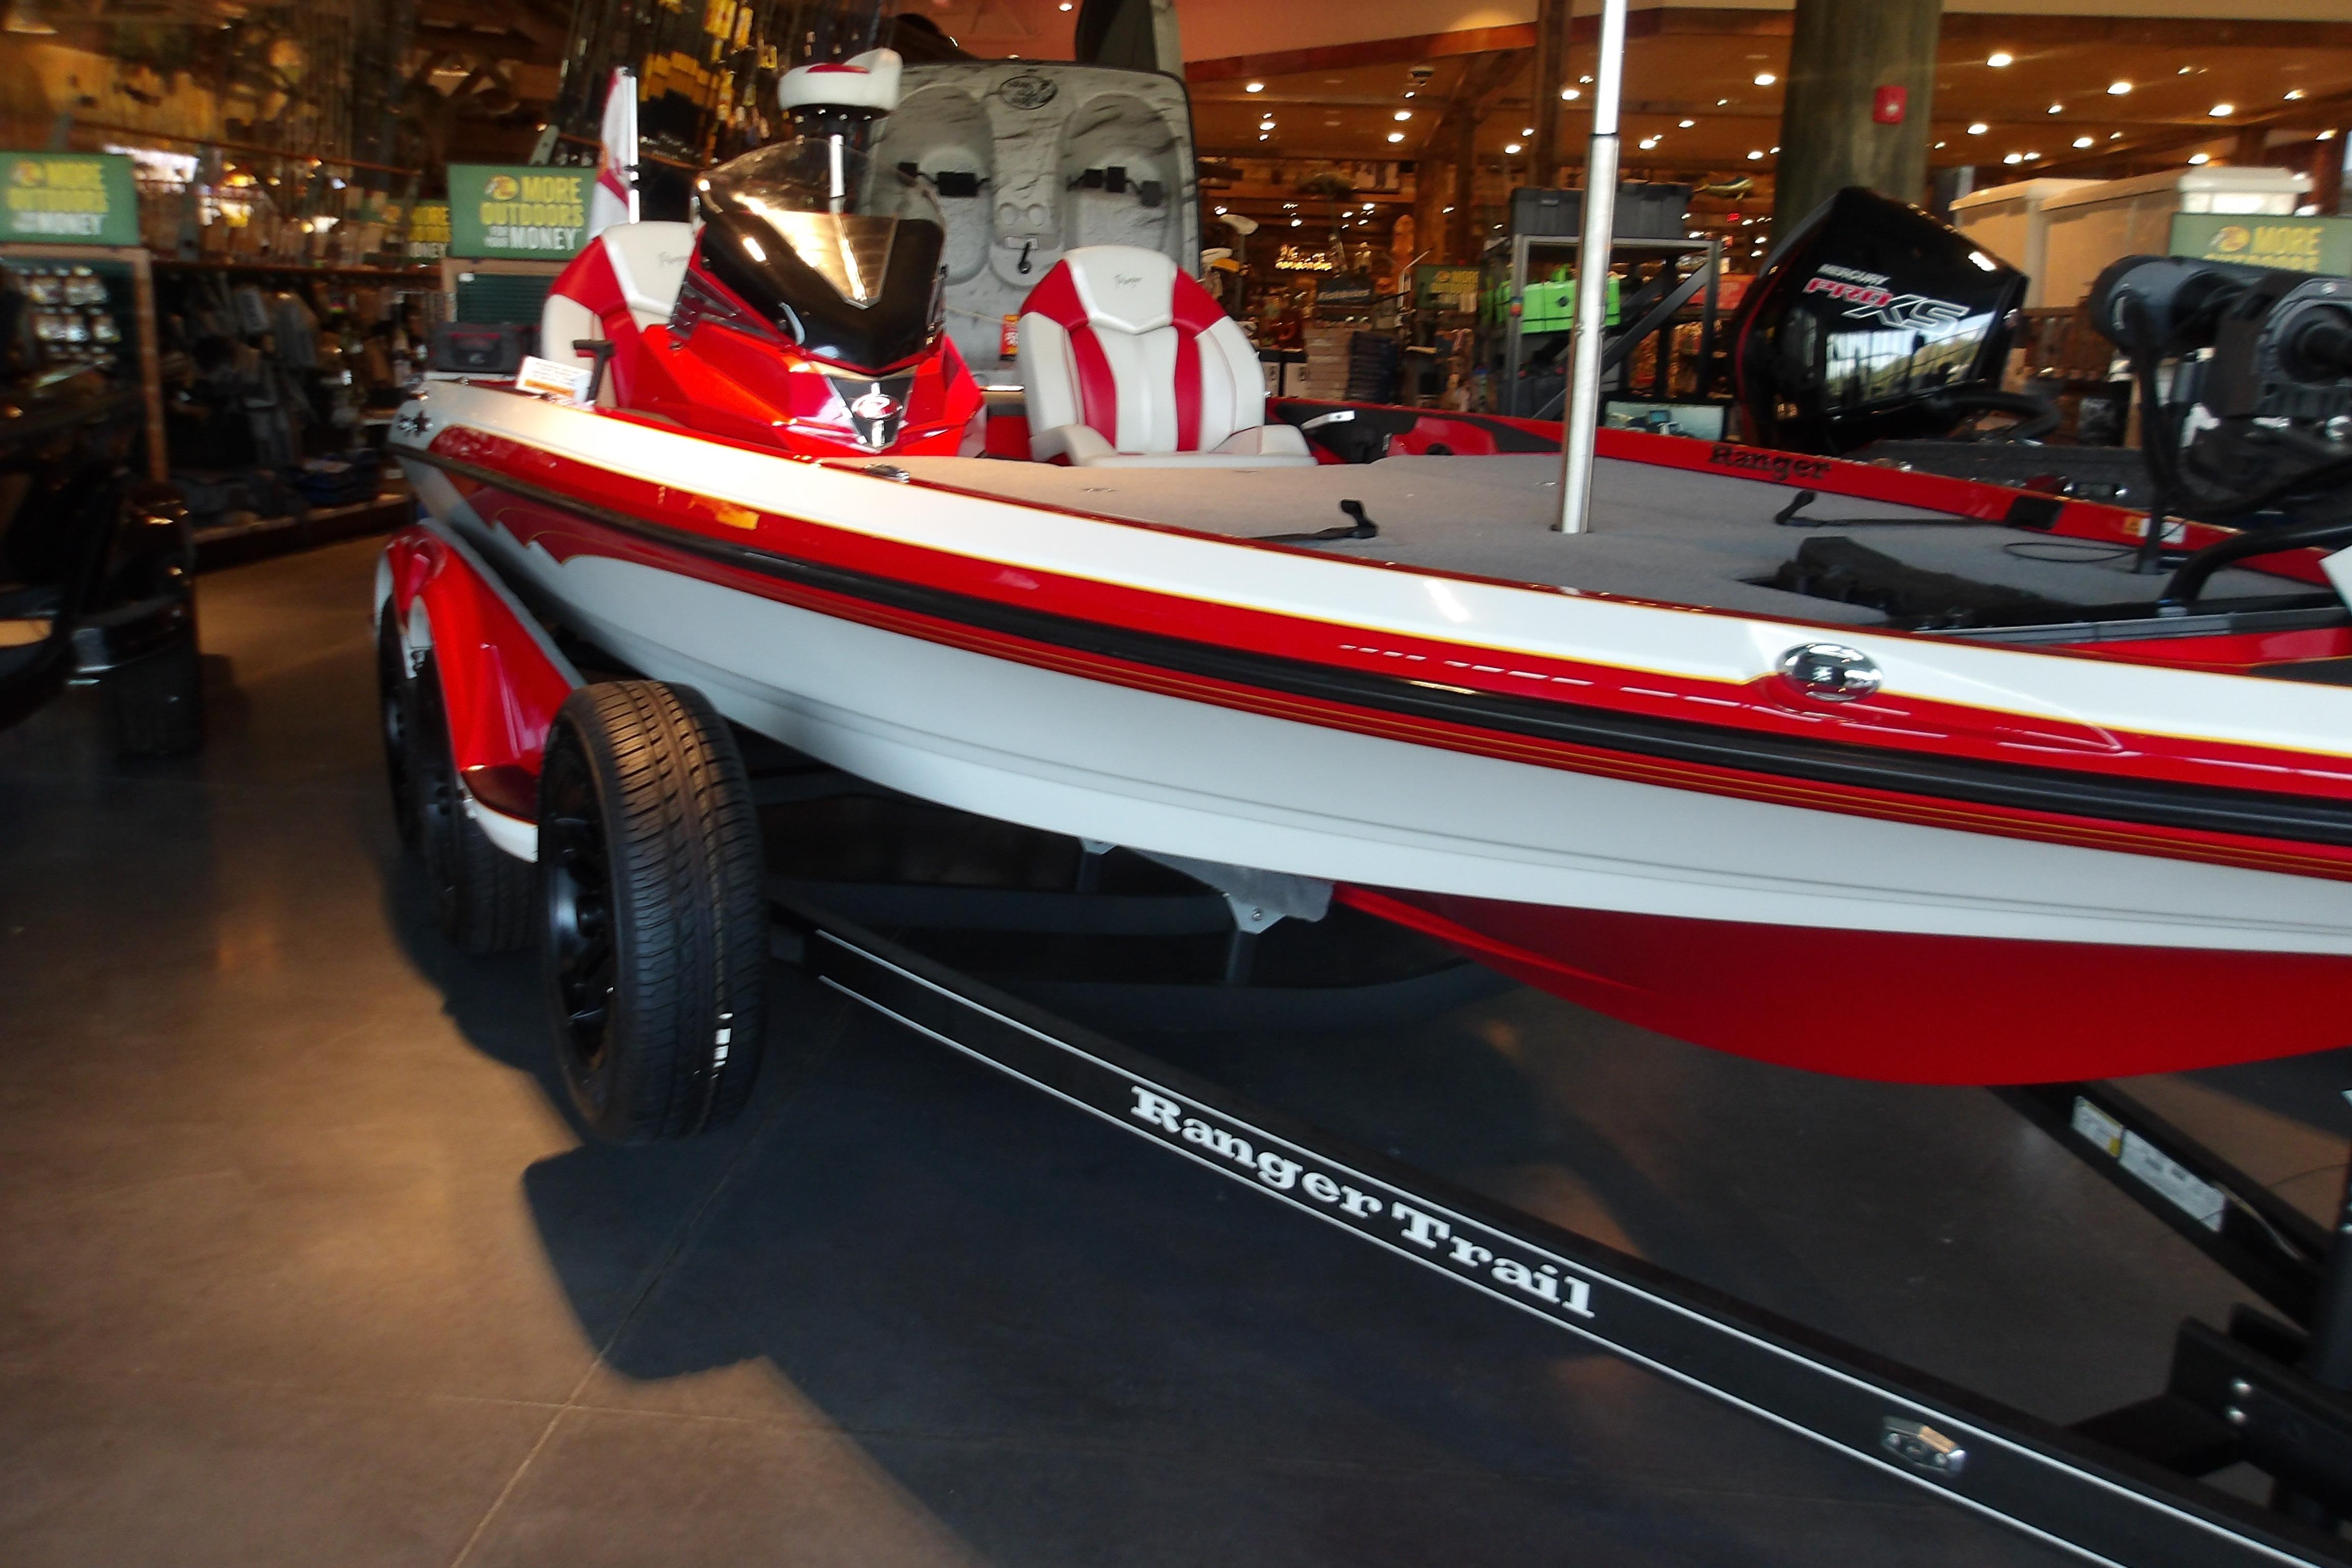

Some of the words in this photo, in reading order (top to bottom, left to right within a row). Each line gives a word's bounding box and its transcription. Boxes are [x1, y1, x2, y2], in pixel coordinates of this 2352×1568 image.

[521, 176, 582, 204] MORE
[480, 202, 584, 227] OUTDOORS
[509, 226, 583, 250] MONEY
[2252, 226, 2324, 255] MORE
[1802, 277, 1894, 307] PRO
[1841, 293, 1971, 335] XS
[1709, 445, 1831, 481] Ranger
[1131, 1085, 1382, 1218] Ranger
[1391, 1201, 1595, 1318] Trail
